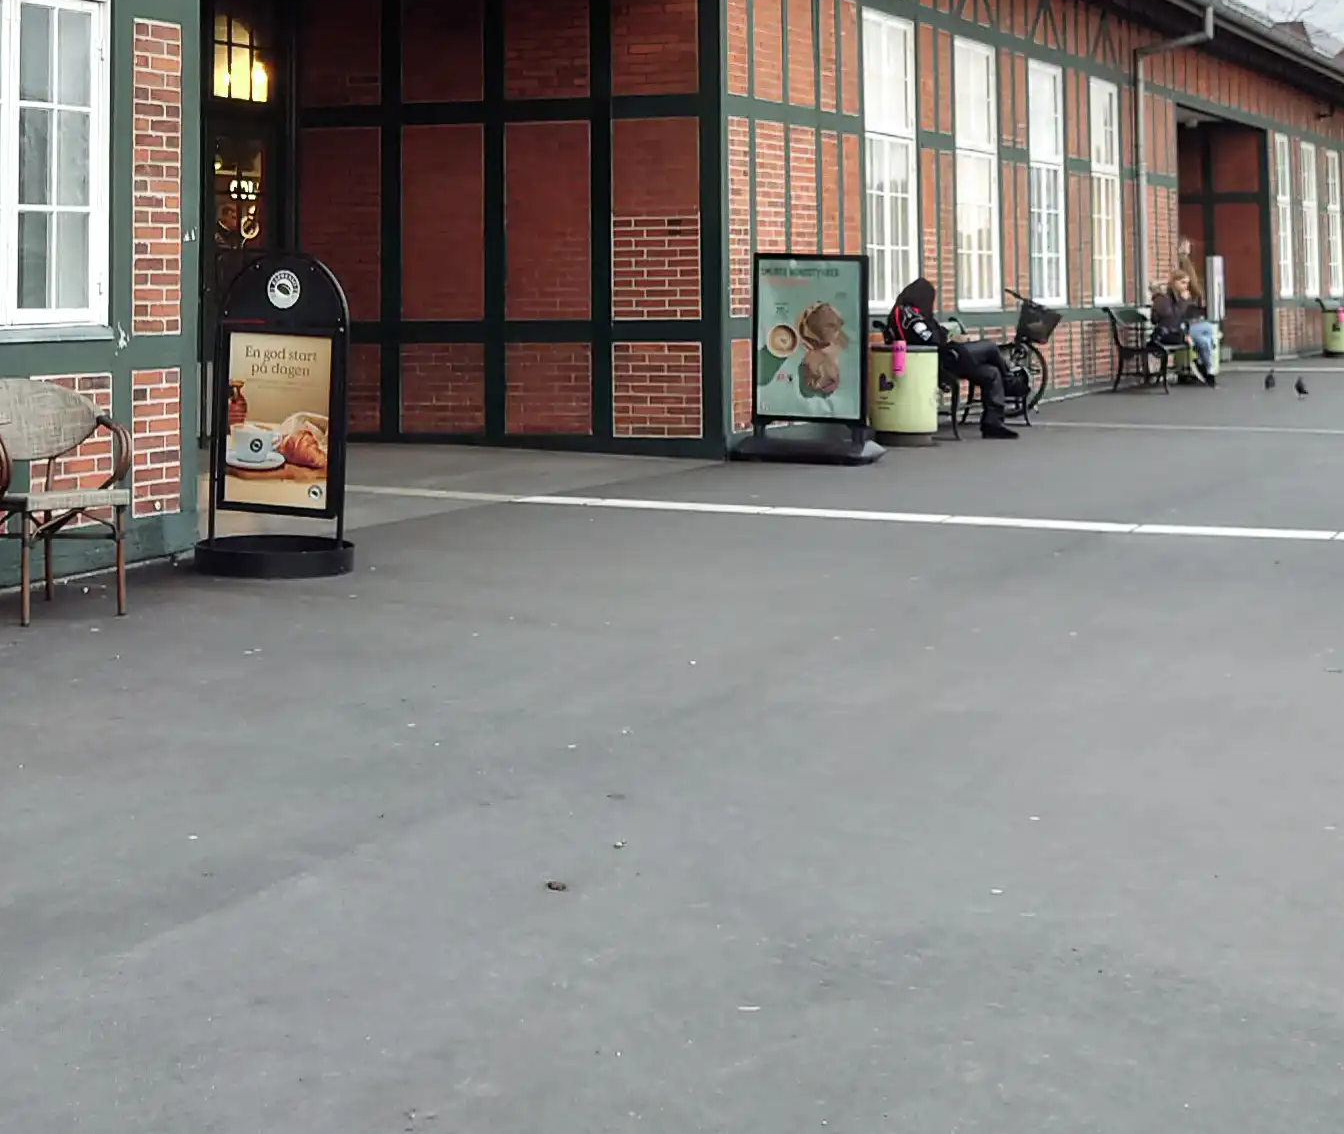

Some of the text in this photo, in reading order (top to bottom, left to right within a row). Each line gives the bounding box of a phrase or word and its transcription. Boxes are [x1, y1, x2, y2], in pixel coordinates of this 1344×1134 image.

[245, 345, 317, 362] En god start
[251, 361, 310, 378] på dagen
